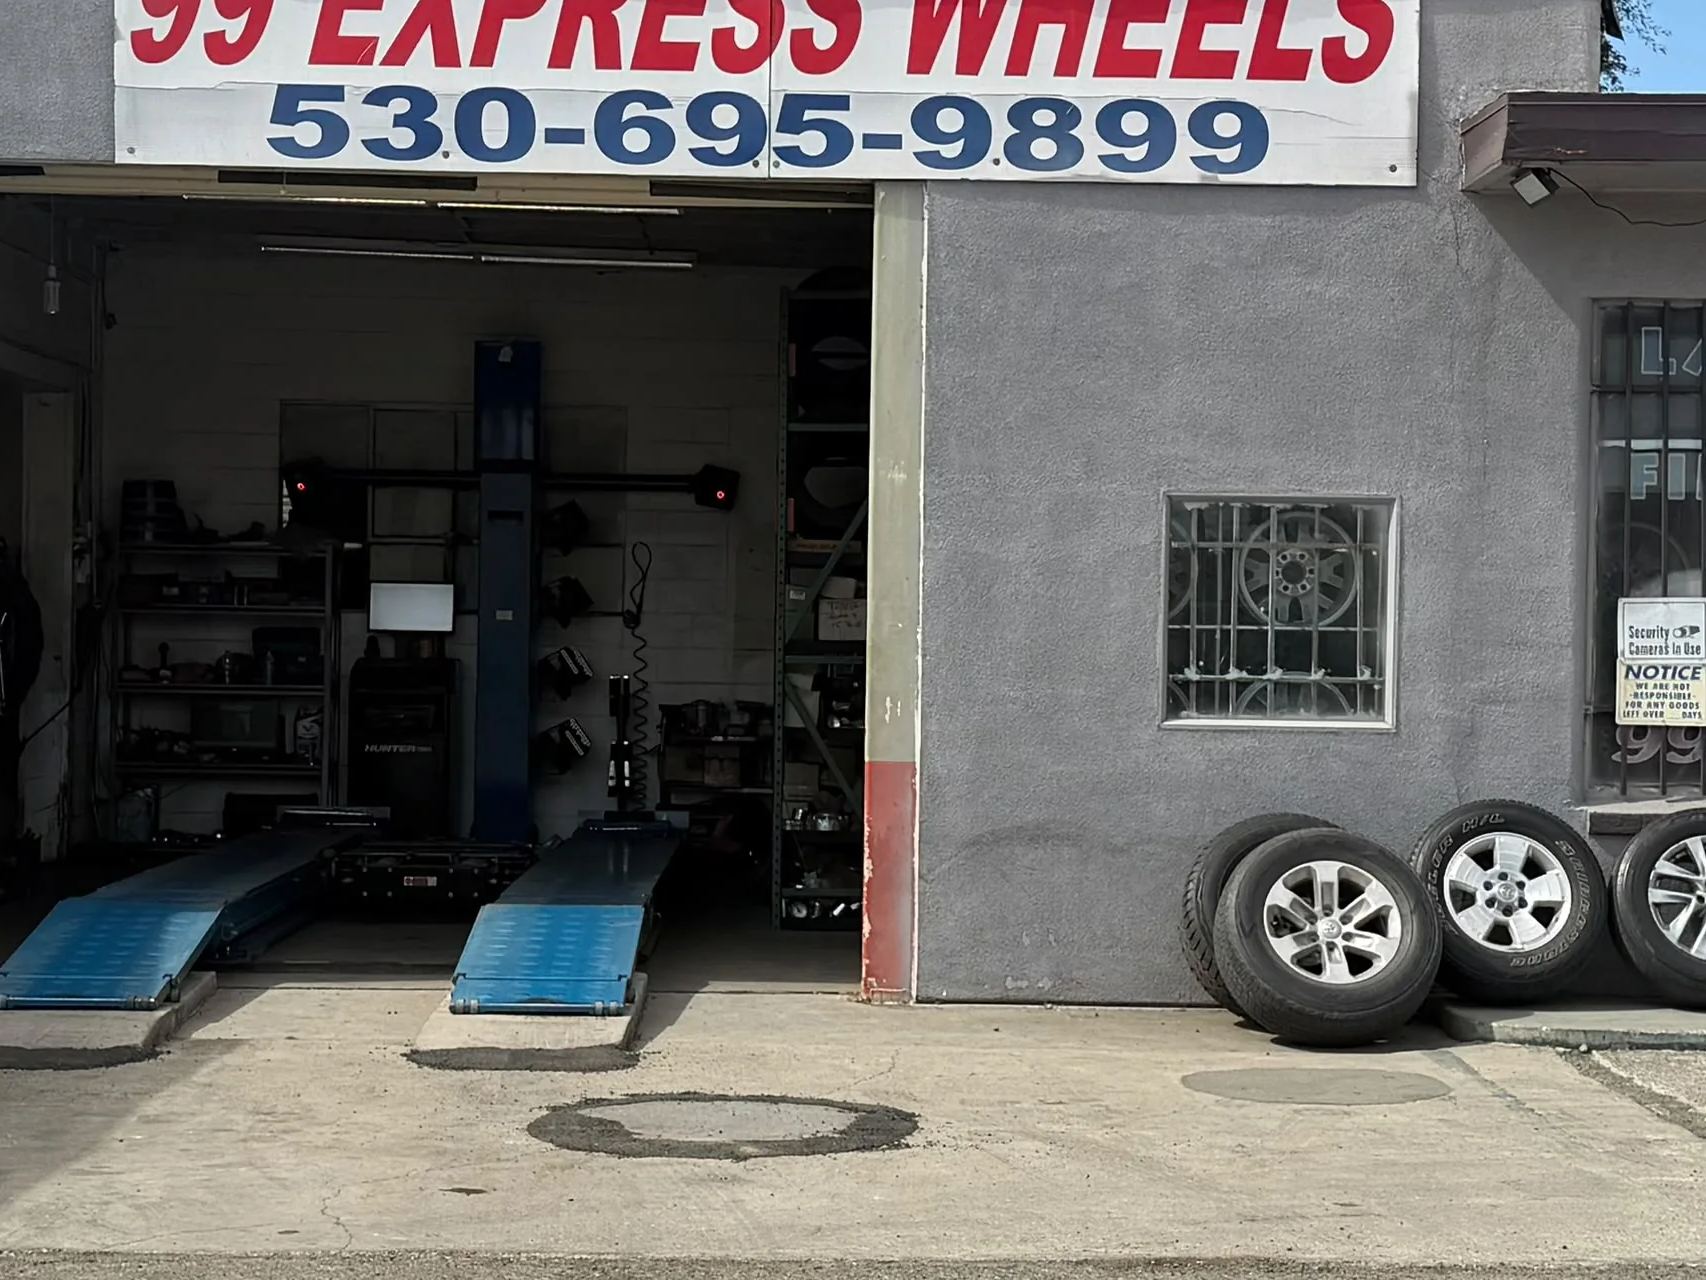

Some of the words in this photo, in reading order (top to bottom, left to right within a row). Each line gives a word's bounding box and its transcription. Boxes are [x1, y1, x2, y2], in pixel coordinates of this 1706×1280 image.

[266, 83, 1269, 176] 530-695-9899
[1629, 625, 1670, 640] Security
[1629, 642, 1669, 655] Cameras
[1684, 642, 1701, 655] Use
[1625, 665, 1702, 680] NOTICE
[1636, 682, 1648, 690] WE
[1625, 701, 1642, 709] FOR
[1646, 701, 1665, 709] ANY
[1669, 701, 1700, 710] GOODS
[1643, 710, 1664, 718] OVER
[1682, 711, 1702, 719] DAYS
